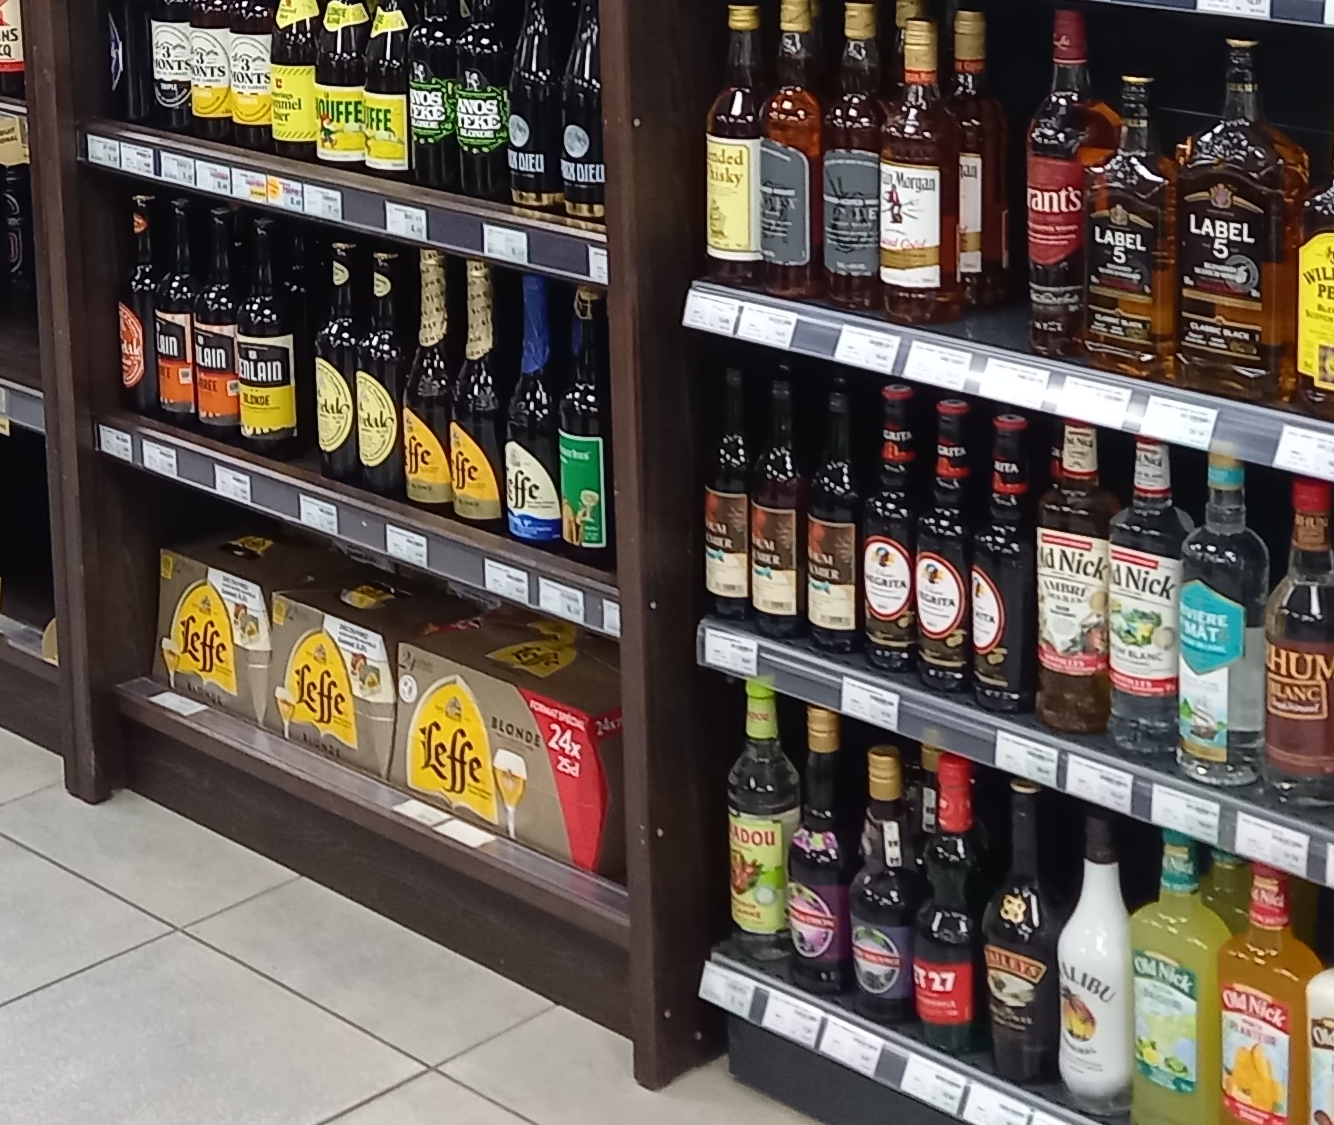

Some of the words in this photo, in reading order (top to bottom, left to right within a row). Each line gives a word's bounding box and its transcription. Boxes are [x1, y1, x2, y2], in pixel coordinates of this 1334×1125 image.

[162, 46, 171, 58] 3
[195, 51, 205, 65] 3
[193, 65, 226, 77] ONTS
[241, 58, 250, 71] 3
[318, 100, 365, 123] OUFFE
[519, 153, 545, 173] DIEU
[577, 163, 605, 183] DIEU
[896, 171, 935, 192] Morgan
[1027, 187, 1082, 212] rant's
[1095, 226, 1147, 252] LABEL
[1190, 214, 1255, 243] LABEL
[1114, 246, 1126, 264] 5
[1213, 239, 1229, 259] 5
[1223, 328, 1250, 341] BLACK
[239, 360, 283, 382] ENLAIN
[243, 394, 270, 406] BLONDE
[1040, 547, 1055, 570] ld
[1059, 547, 1107, 582] Nick
[1123, 564, 1176, 601] Nick
[180, 614, 228, 673] Leffe
[1127, 649, 1163, 662] BLANC
[296, 664, 346, 724] Leffe
[491, 716, 541, 748] BLONDE
[548, 724, 582, 759] 24x
[420, 721, 482, 794] Leffe
[1061, 962, 1115, 1004] ALIBU
[1134, 957, 1156, 978] Old
[1157, 965, 1193, 993] Nick
[1223, 988, 1247, 1009] Old
[1247, 992, 1286, 1027] Nick
